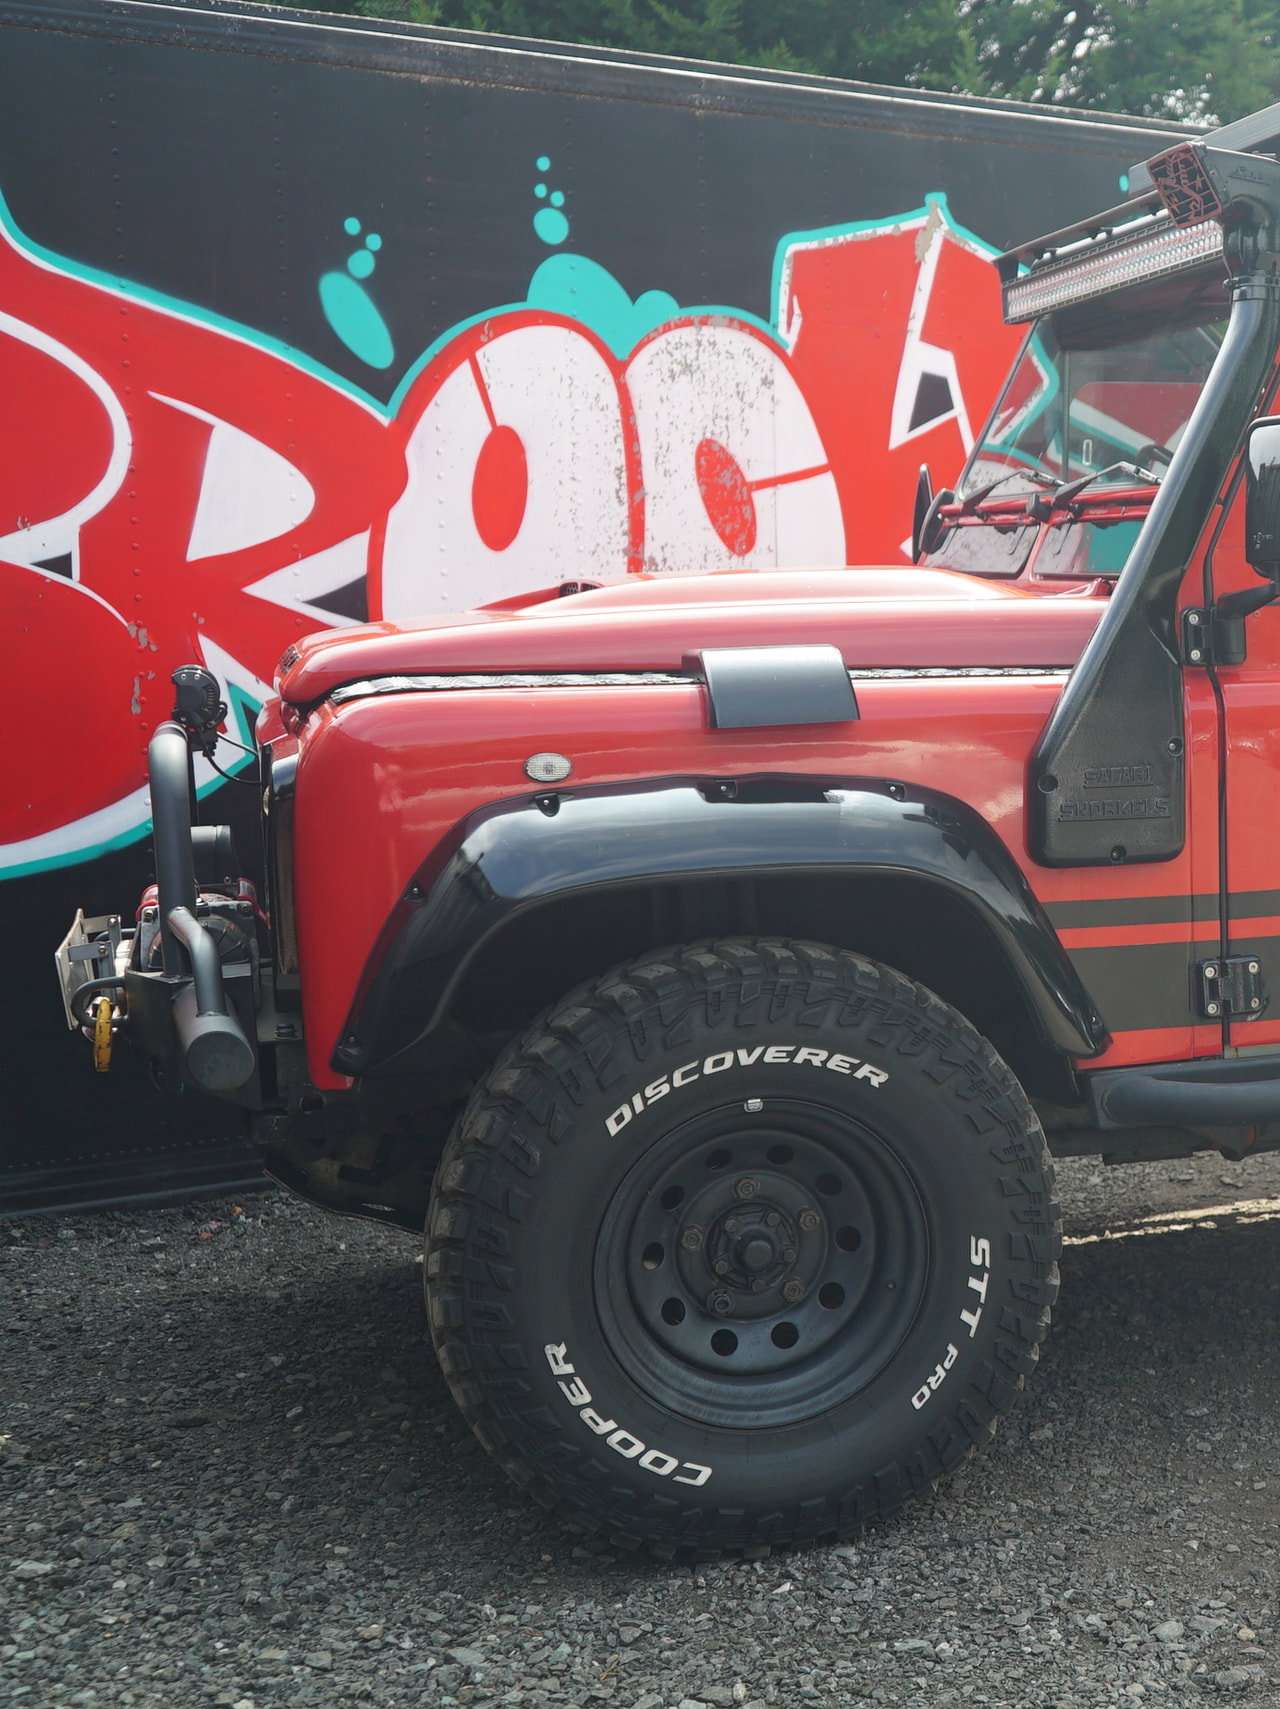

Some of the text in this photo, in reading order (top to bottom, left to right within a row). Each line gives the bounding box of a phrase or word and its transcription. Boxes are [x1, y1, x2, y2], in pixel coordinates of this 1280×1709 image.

[604, 1045, 889, 1137] DISCOVERER
[911, 1234, 991, 1410] STT PRO
[543, 1341, 713, 1487] COOPER
